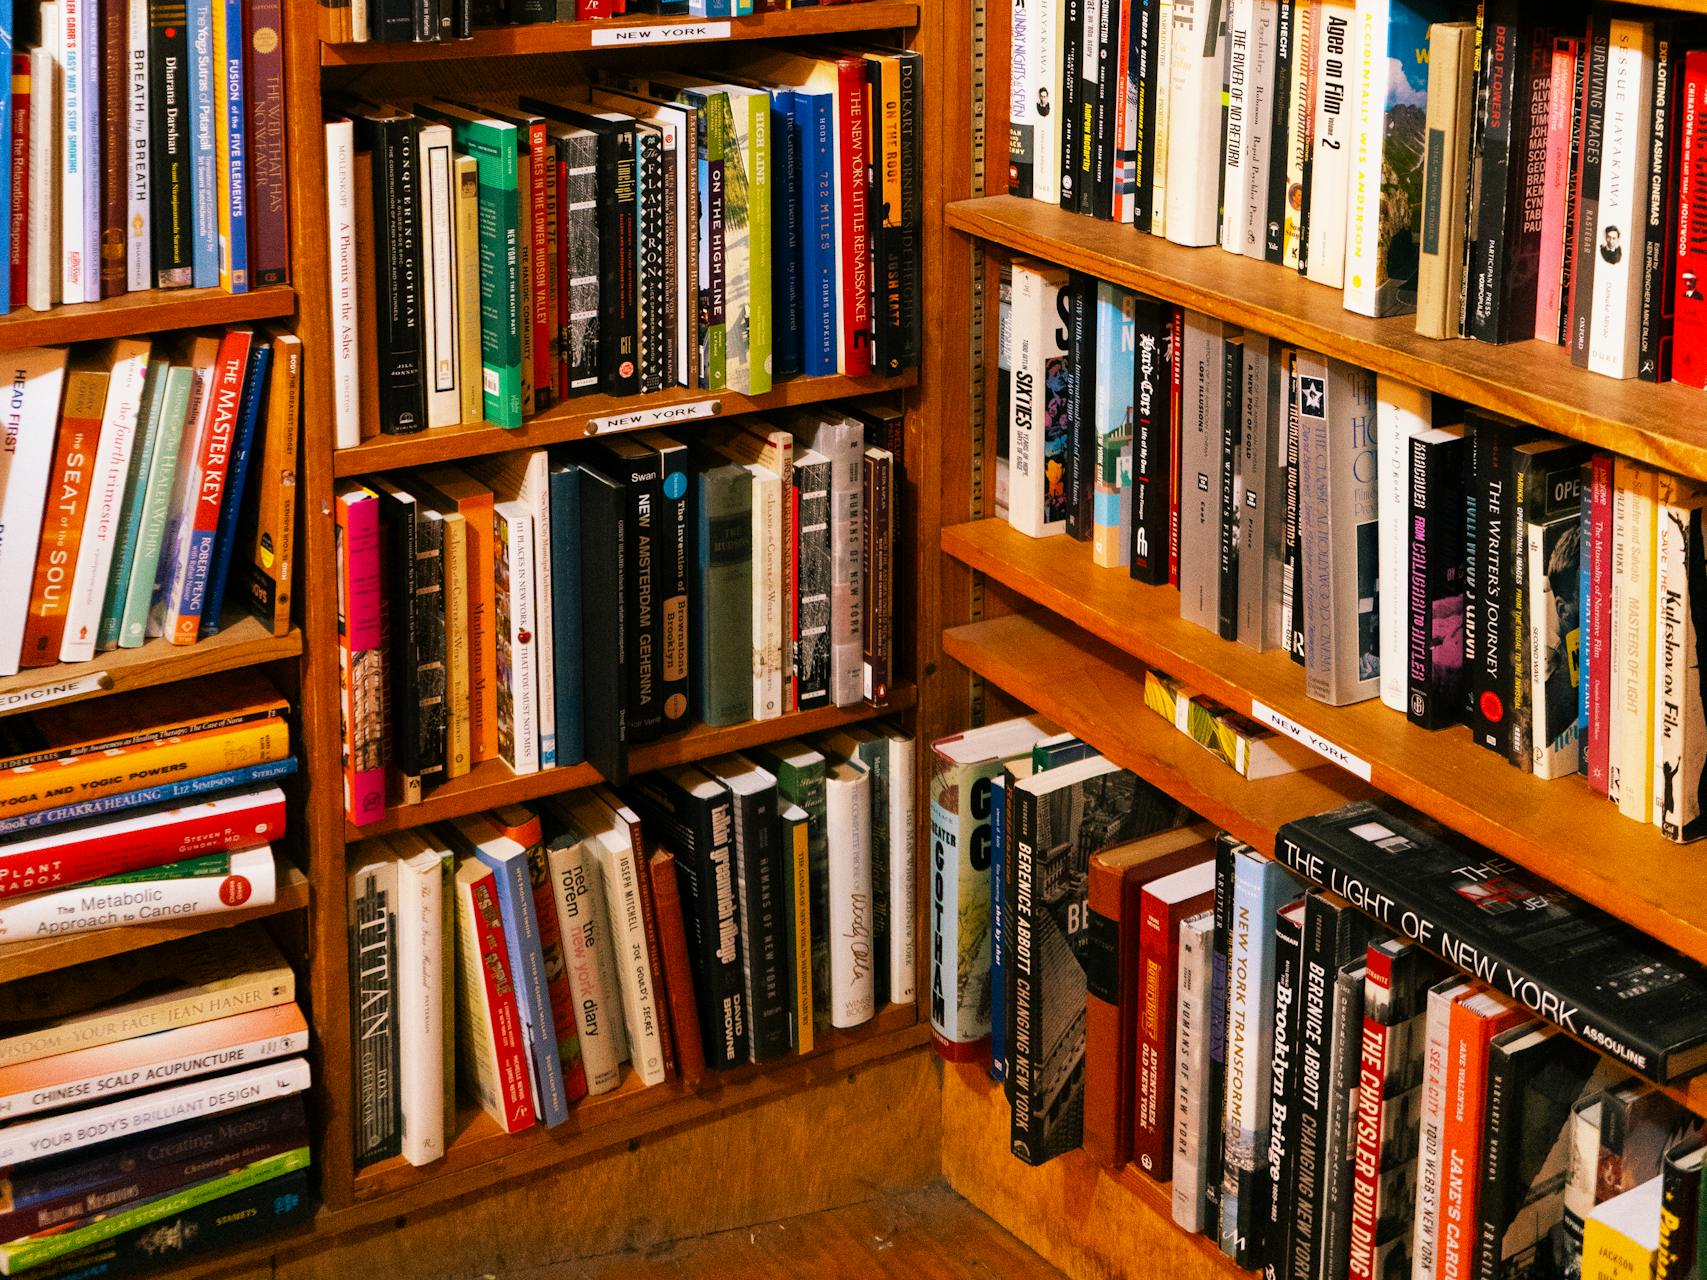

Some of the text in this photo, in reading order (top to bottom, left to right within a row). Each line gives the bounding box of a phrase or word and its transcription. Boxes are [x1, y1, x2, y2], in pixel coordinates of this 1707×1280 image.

[229, 59, 239, 101] FUSION
[662, 27, 706, 36] YORK
[135, 50, 145, 201] BREATH by BREATH
[166, 57, 177, 154] Dharana Darshan
[1322, 16, 1347, 150] Agee on Film 2
[231, 134, 241, 156] FIVE
[231, 159, 242, 217] ELEMENTS
[712, 169, 723, 315] ON THE HIGH LINE
[4, 369, 26, 455] HEAD FIRST
[205, 360, 239, 506] THE MASTER KEY
[608, 406, 697, 428] NEW YORK
[40, 433, 84, 618] the SEAT of the SOUL
[637, 493, 652, 705] NEW AMSTERDAM GEHENNA
[0, 762, 188, 807] YOGA AND YOGIC POWERS
[37, 900, 198, 934] Approach to Cancer
[57, 890, 162, 915] The Metabolic
[361, 906, 388, 1040] TITAN
[1015, 842, 1032, 1132] BERENICE ABBOTT CHANGING NEW YORK
[1284, 839, 1647, 1070] THE LIGHT OF NEW YORK ASSOULINE
[30, 1133, 72, 1152] YOUR
[77, 1118, 129, 1141] BODY'S
[133, 1100, 204, 1128] BRILLIANT
[209, 1085, 260, 1107] DESIGN
[32, 1049, 244, 1106] CHINESE SCALP ACUPUNCTURE
[1269, 983, 1292, 1181] Brooklyn Bridge
[1351, 1027, 1382, 1275] THE CHRYSLER BUILDING
